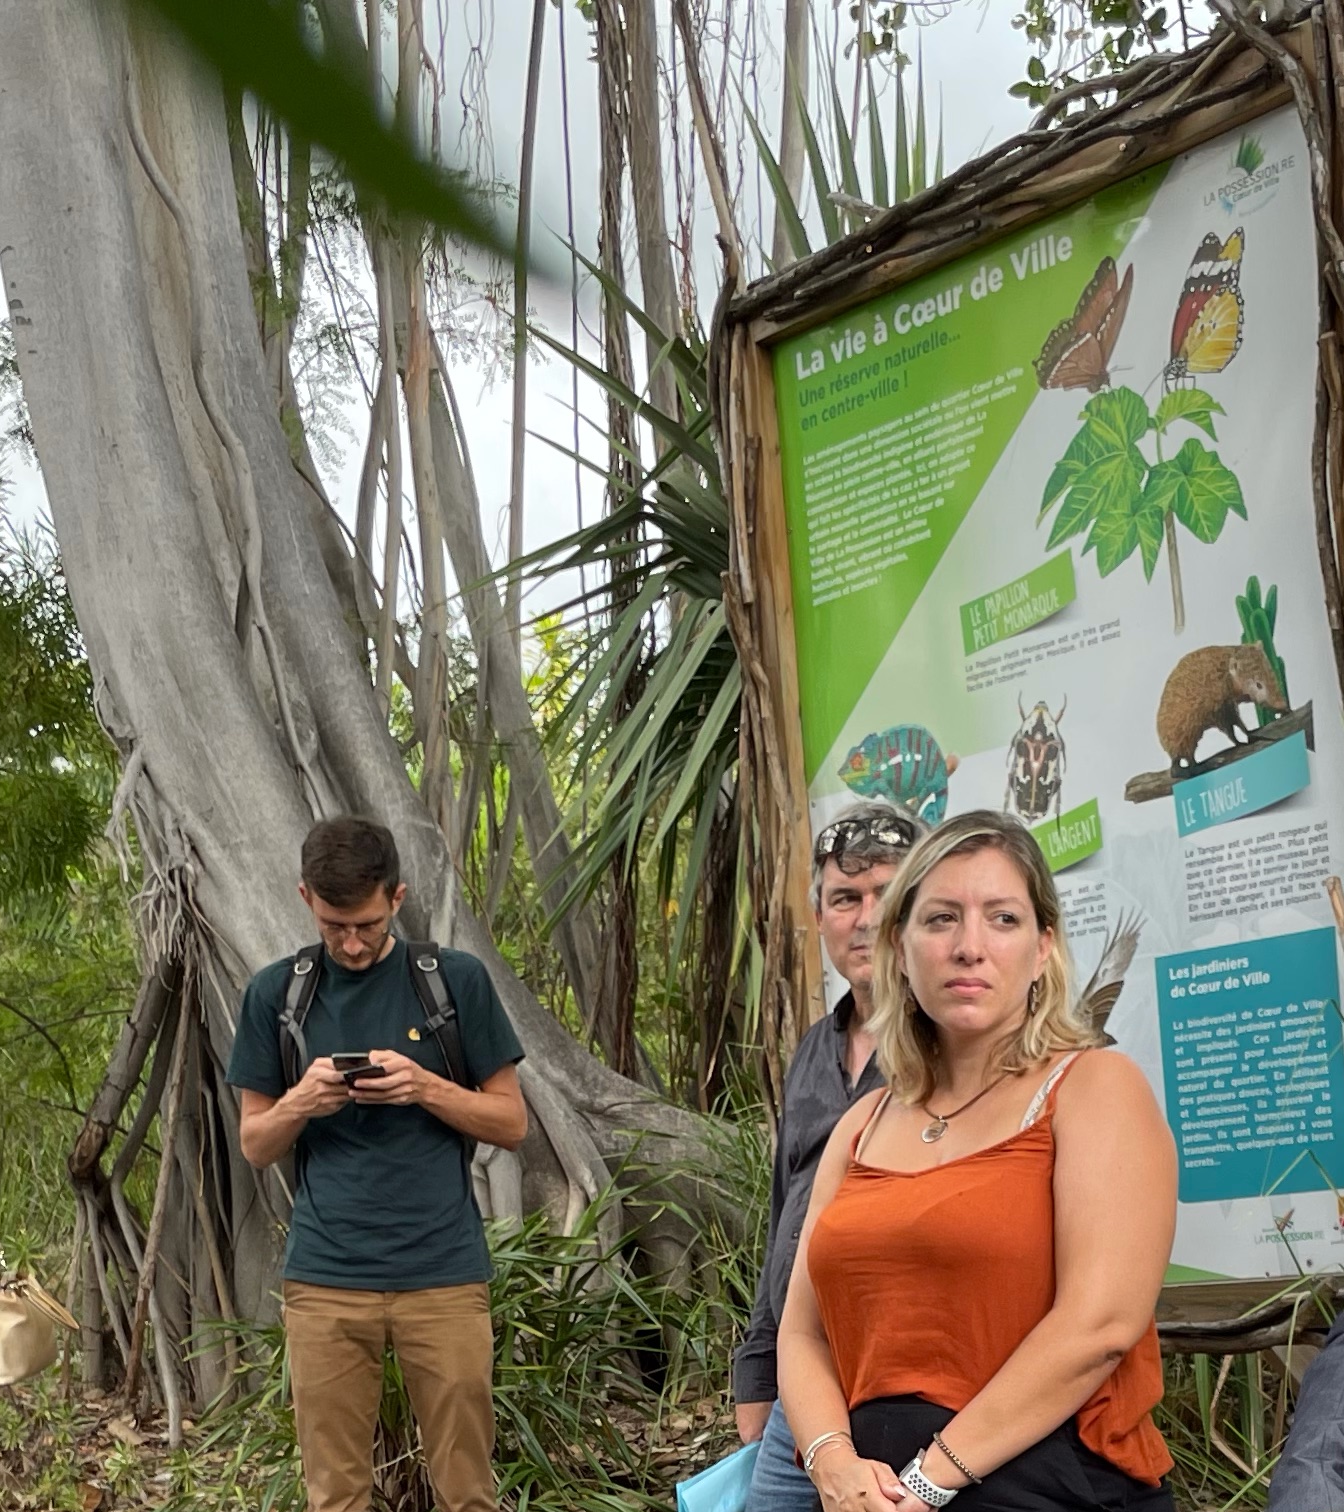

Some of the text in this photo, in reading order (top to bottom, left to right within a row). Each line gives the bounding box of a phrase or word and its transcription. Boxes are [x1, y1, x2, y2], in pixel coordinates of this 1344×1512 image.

[1204, 192, 1216, 206] LA
[796, 236, 1072, 379] La vie à Cœur de Ville
[799, 332, 959, 407] Une réserve naturelle...
[801, 370, 908, 431] en centre-ville !
[970, 581, 1029, 626] LE PAPILLON
[973, 590, 1058, 649] PETIT MONARQUE
[1181, 777, 1247, 827] LE TANGUE
[1169, 958, 1248, 980] Les jardiniers
[1170, 972, 1270, 998] de Cœur de Ville
